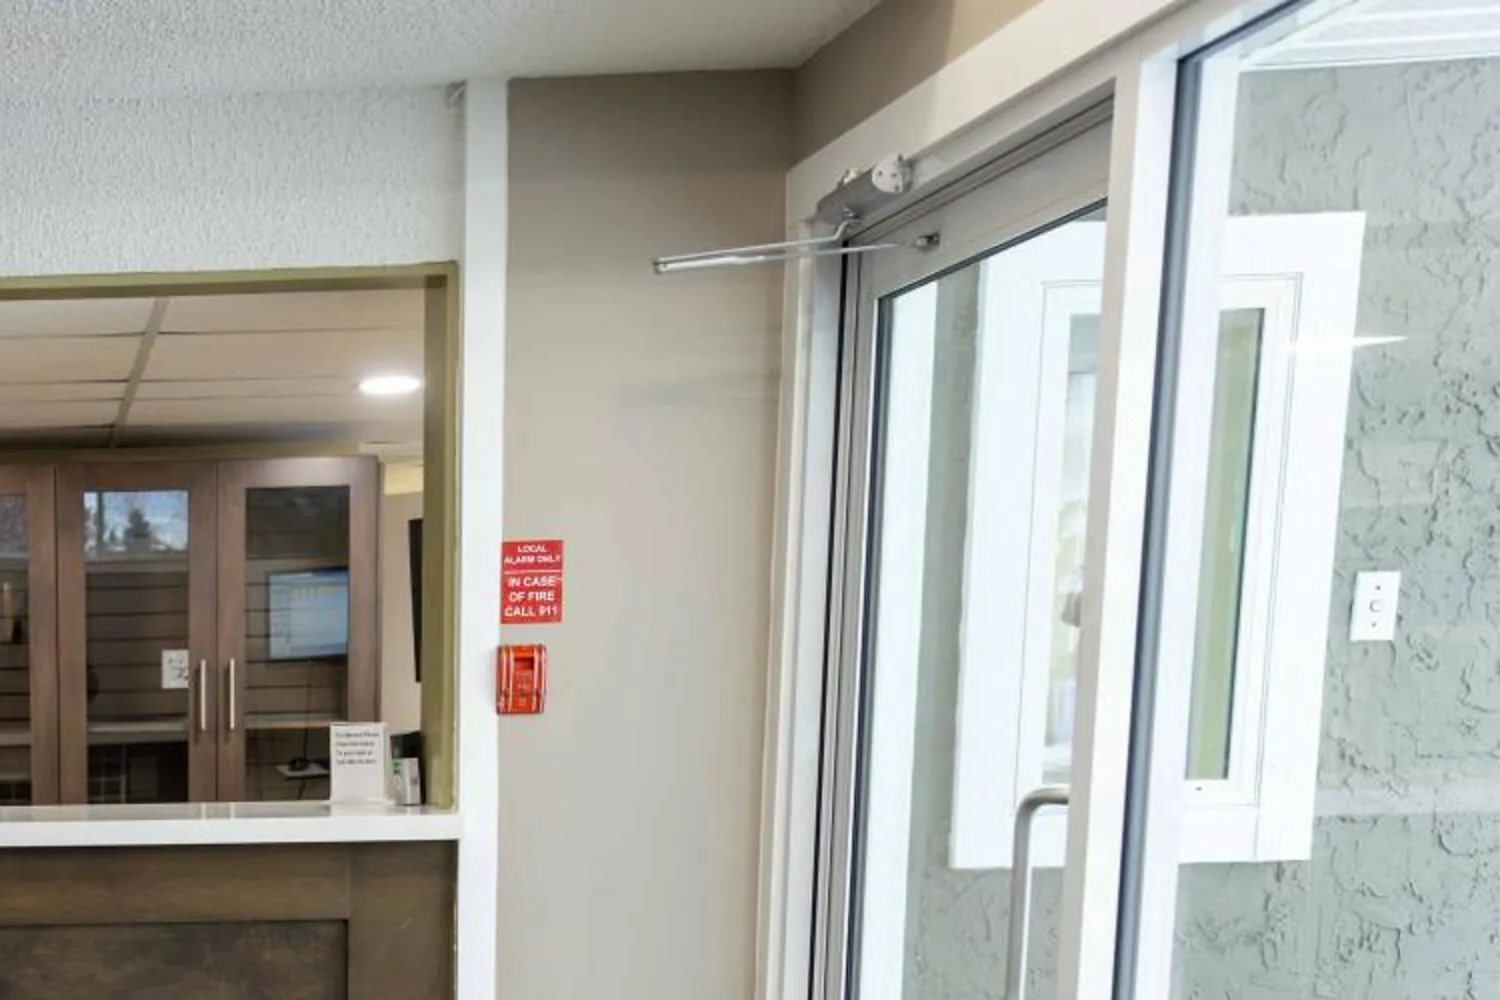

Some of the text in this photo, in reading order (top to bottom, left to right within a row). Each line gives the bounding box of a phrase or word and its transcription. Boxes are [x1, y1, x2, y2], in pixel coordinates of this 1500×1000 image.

[517, 544, 547, 553] LOCAL
[504, 554, 561, 564] ALARM ONLY
[508, 575, 556, 587] IN CASE
[509, 590, 555, 602] OF FIRE
[504, 605, 558, 617] CALL 911
